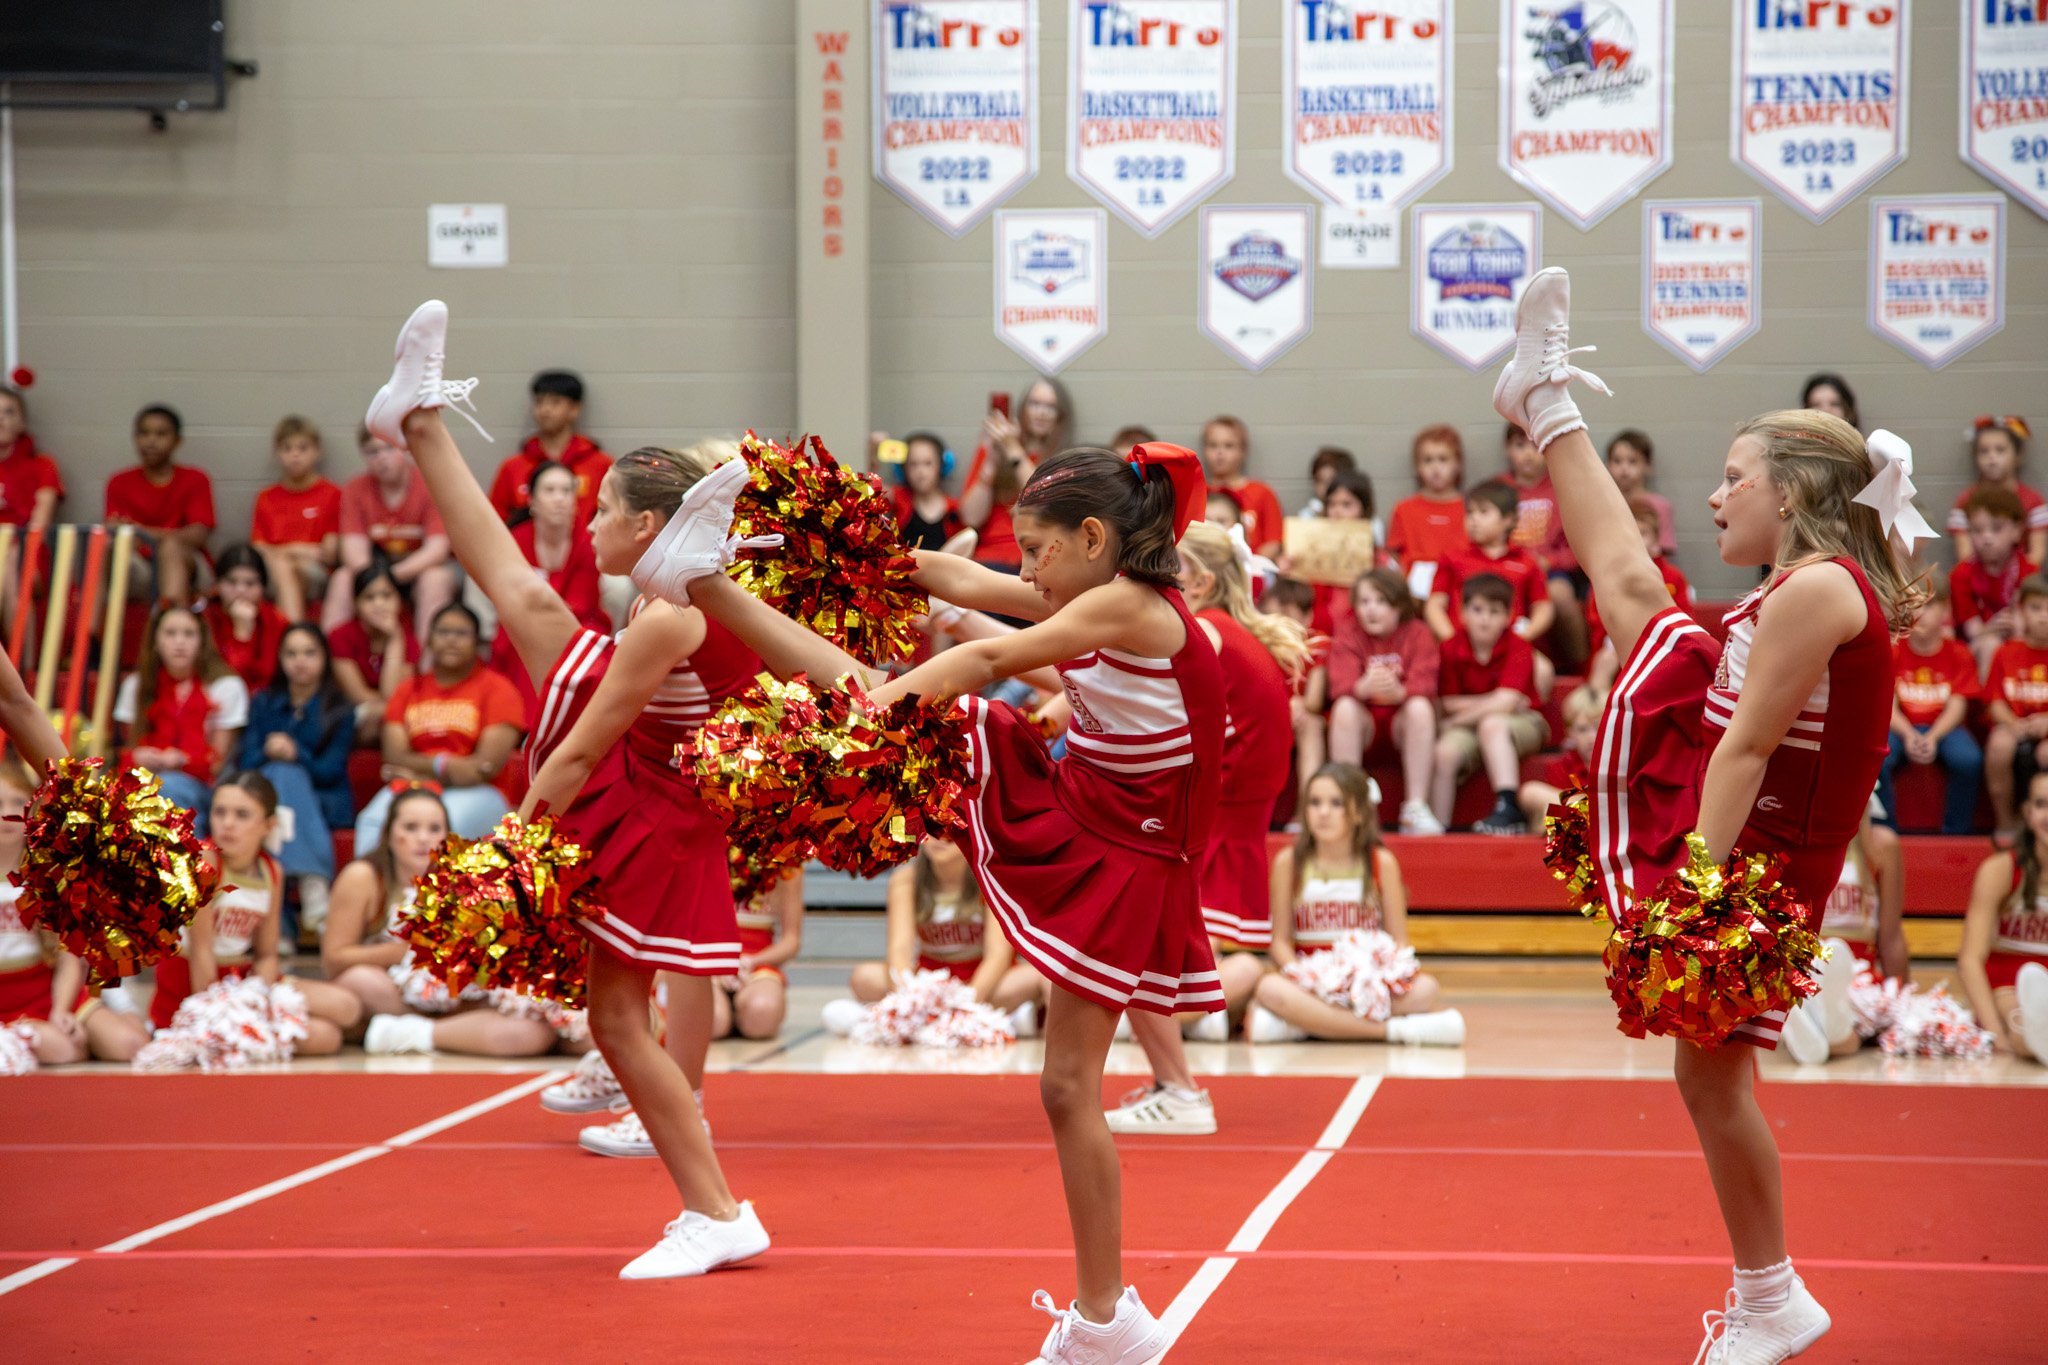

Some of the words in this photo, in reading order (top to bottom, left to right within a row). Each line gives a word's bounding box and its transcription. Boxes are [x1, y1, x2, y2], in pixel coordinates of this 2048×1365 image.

[1299, 84, 1437, 114] BASKETBALL
[1747, 72, 1893, 103] TENNIS
[888, 92, 1021, 118] VOLLEYBALL
[1083, 91, 1219, 118] BASKETBALL
[1297, 112, 1440, 145] CHAMPIONS
[1745, 102, 1893, 136] CHAMPION
[813, 31, 850, 258] WARRIORS
[885, 119, 1022, 150] CHAMPION
[1080, 119, 1222, 149] CHAMPIONS
[1513, 128, 1658, 161] CHAMPION
[1331, 150, 1405, 176] 2022
[1781, 139, 1856, 166] 2023
[920, 157, 991, 182] 2022
[1115, 156, 1186, 181] 2022
[1657, 281, 1748, 301] TENNIS
[1432, 307, 1516, 330] RUNNER-U
